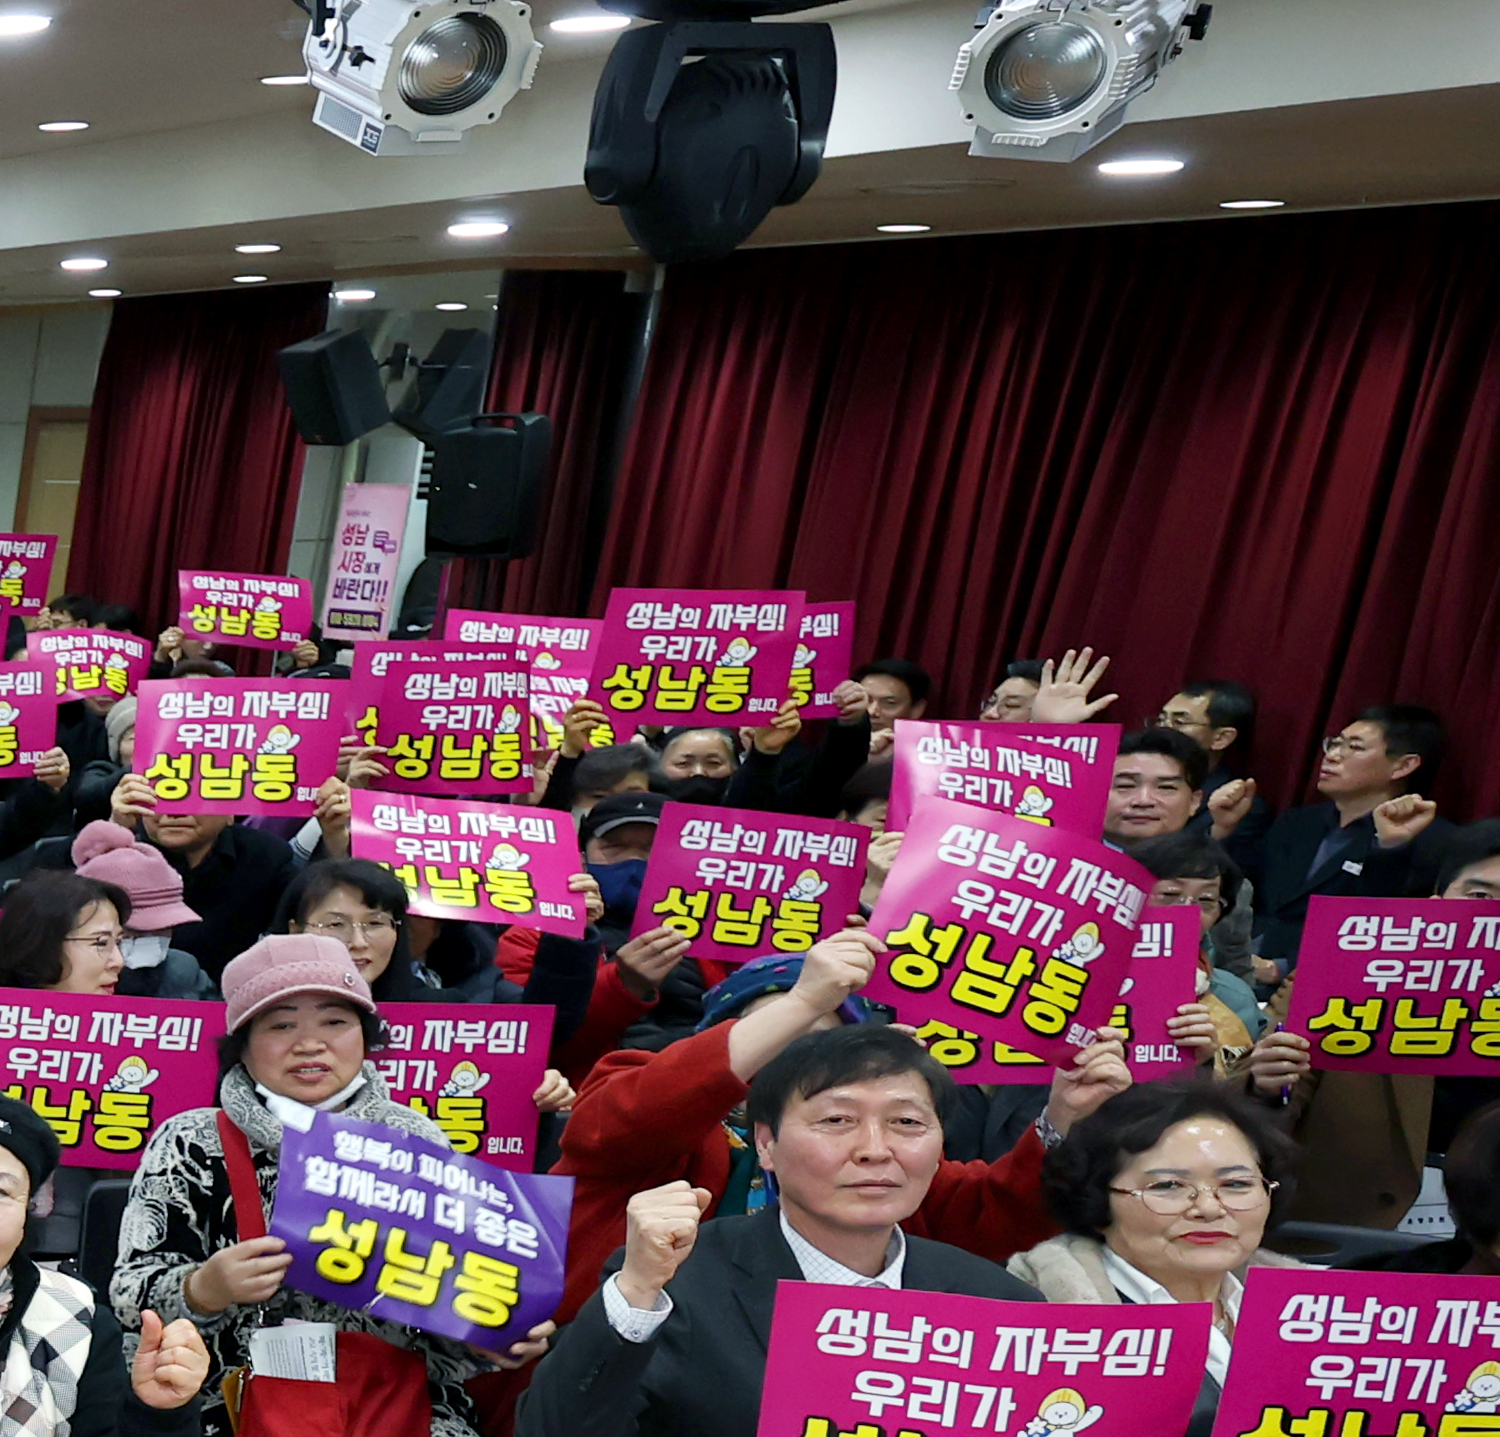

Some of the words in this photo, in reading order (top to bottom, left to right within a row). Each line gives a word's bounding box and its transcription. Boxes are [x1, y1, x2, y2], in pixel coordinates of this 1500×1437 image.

[343, 523, 369, 546] 성남
[333, 578, 388, 602] 바란다!!
[627, 603, 701, 629] 성남의
[706, 604, 786, 630] 자부심!
[640, 636, 717, 661] 우리가
[158, 692, 234, 719] 성남의
[242, 691, 329, 719] 자부심!
[601, 663, 751, 713] 성남동
[748, 698, 777, 711] 입니다.
[177, 724, 257, 749] 우리가
[147, 752, 297, 802] 성남동
[938, 821, 1056, 884] 성남의
[1057, 859, 1143, 929] 자부심!
[951, 880, 1064, 946] 우리가
[886, 914, 1088, 1039] 성남동
[88, 1012, 202, 1051] 자부심!
[333, 1131, 415, 1176] 행복이
[418, 1155, 514, 1210] 피어나는,
[304, 1155, 426, 1219] 함께라서
[435, 1202, 468, 1235] 더
[473, 1206, 541, 1258] 좋은
[307, 1210, 519, 1326] 성남동
[816, 1309, 974, 1368] 성남의
[990, 1327, 1172, 1375] 자부심!
[1279, 1295, 1417, 1343] 성남의
[852, 1371, 1016, 1431] 우리가
[1306, 1356, 1447, 1403] 우리가
